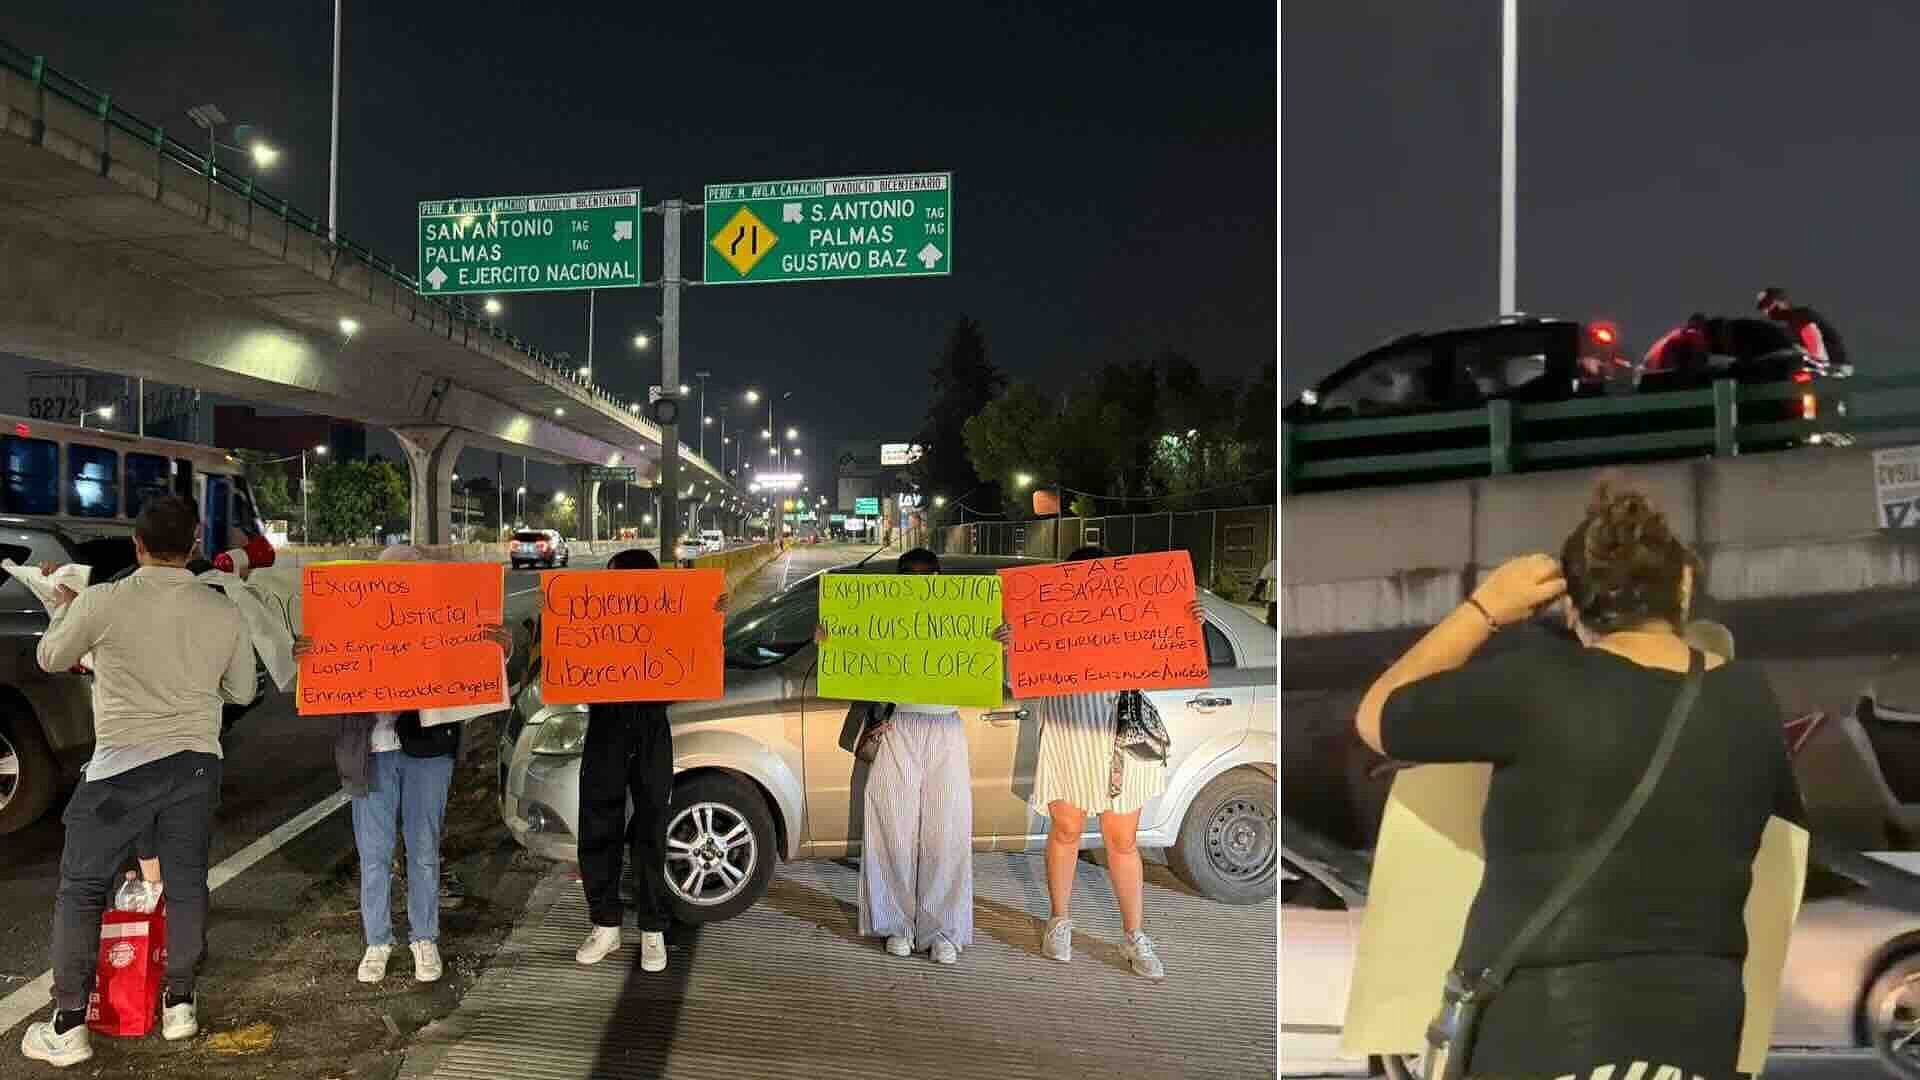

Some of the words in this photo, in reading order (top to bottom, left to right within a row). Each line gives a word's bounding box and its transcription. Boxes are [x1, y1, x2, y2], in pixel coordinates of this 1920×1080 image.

[780, 183, 823, 196] CAMACHO
[832, 182, 875, 194] VIADUCTO
[879, 178, 942, 192] BICENTENARIO
[811, 204, 827, 223] S.
[831, 199, 915, 221] ANTONIO
[925, 207, 945, 219] TAG
[425, 222, 465, 241] SAN
[471, 218, 554, 239] ANTONIO
[571, 220, 590, 233] TAG
[925, 223, 945, 235] TAG
[809, 225, 894, 247] PALMAS
[425, 244, 502, 263] PALMAS
[571, 239, 591, 252] TAG
[782, 251, 861, 273] GUSTAVO
[868, 249, 908, 269] BAZ
[458, 265, 540, 285] EJERCITO
[546, 261, 635, 281] NACIONAL
